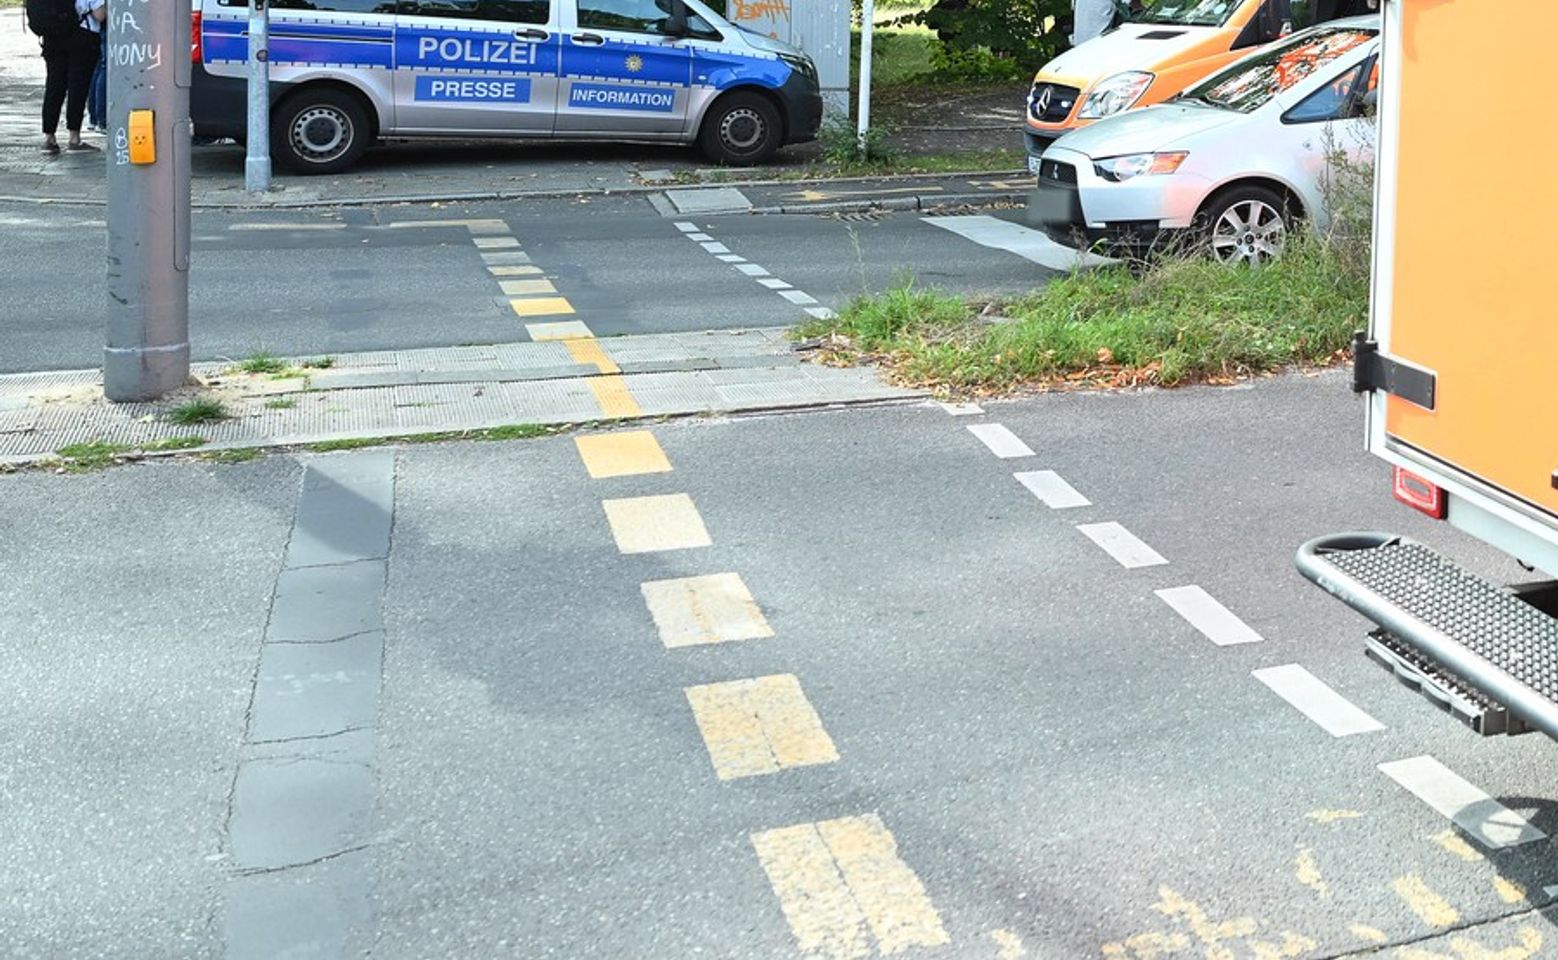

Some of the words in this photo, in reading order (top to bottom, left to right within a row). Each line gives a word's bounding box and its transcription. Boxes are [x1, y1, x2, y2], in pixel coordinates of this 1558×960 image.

[418, 37, 537, 65] POLIZEI
[430, 80, 516, 99] PRESSE
[571, 88, 673, 107] INFORMATION
